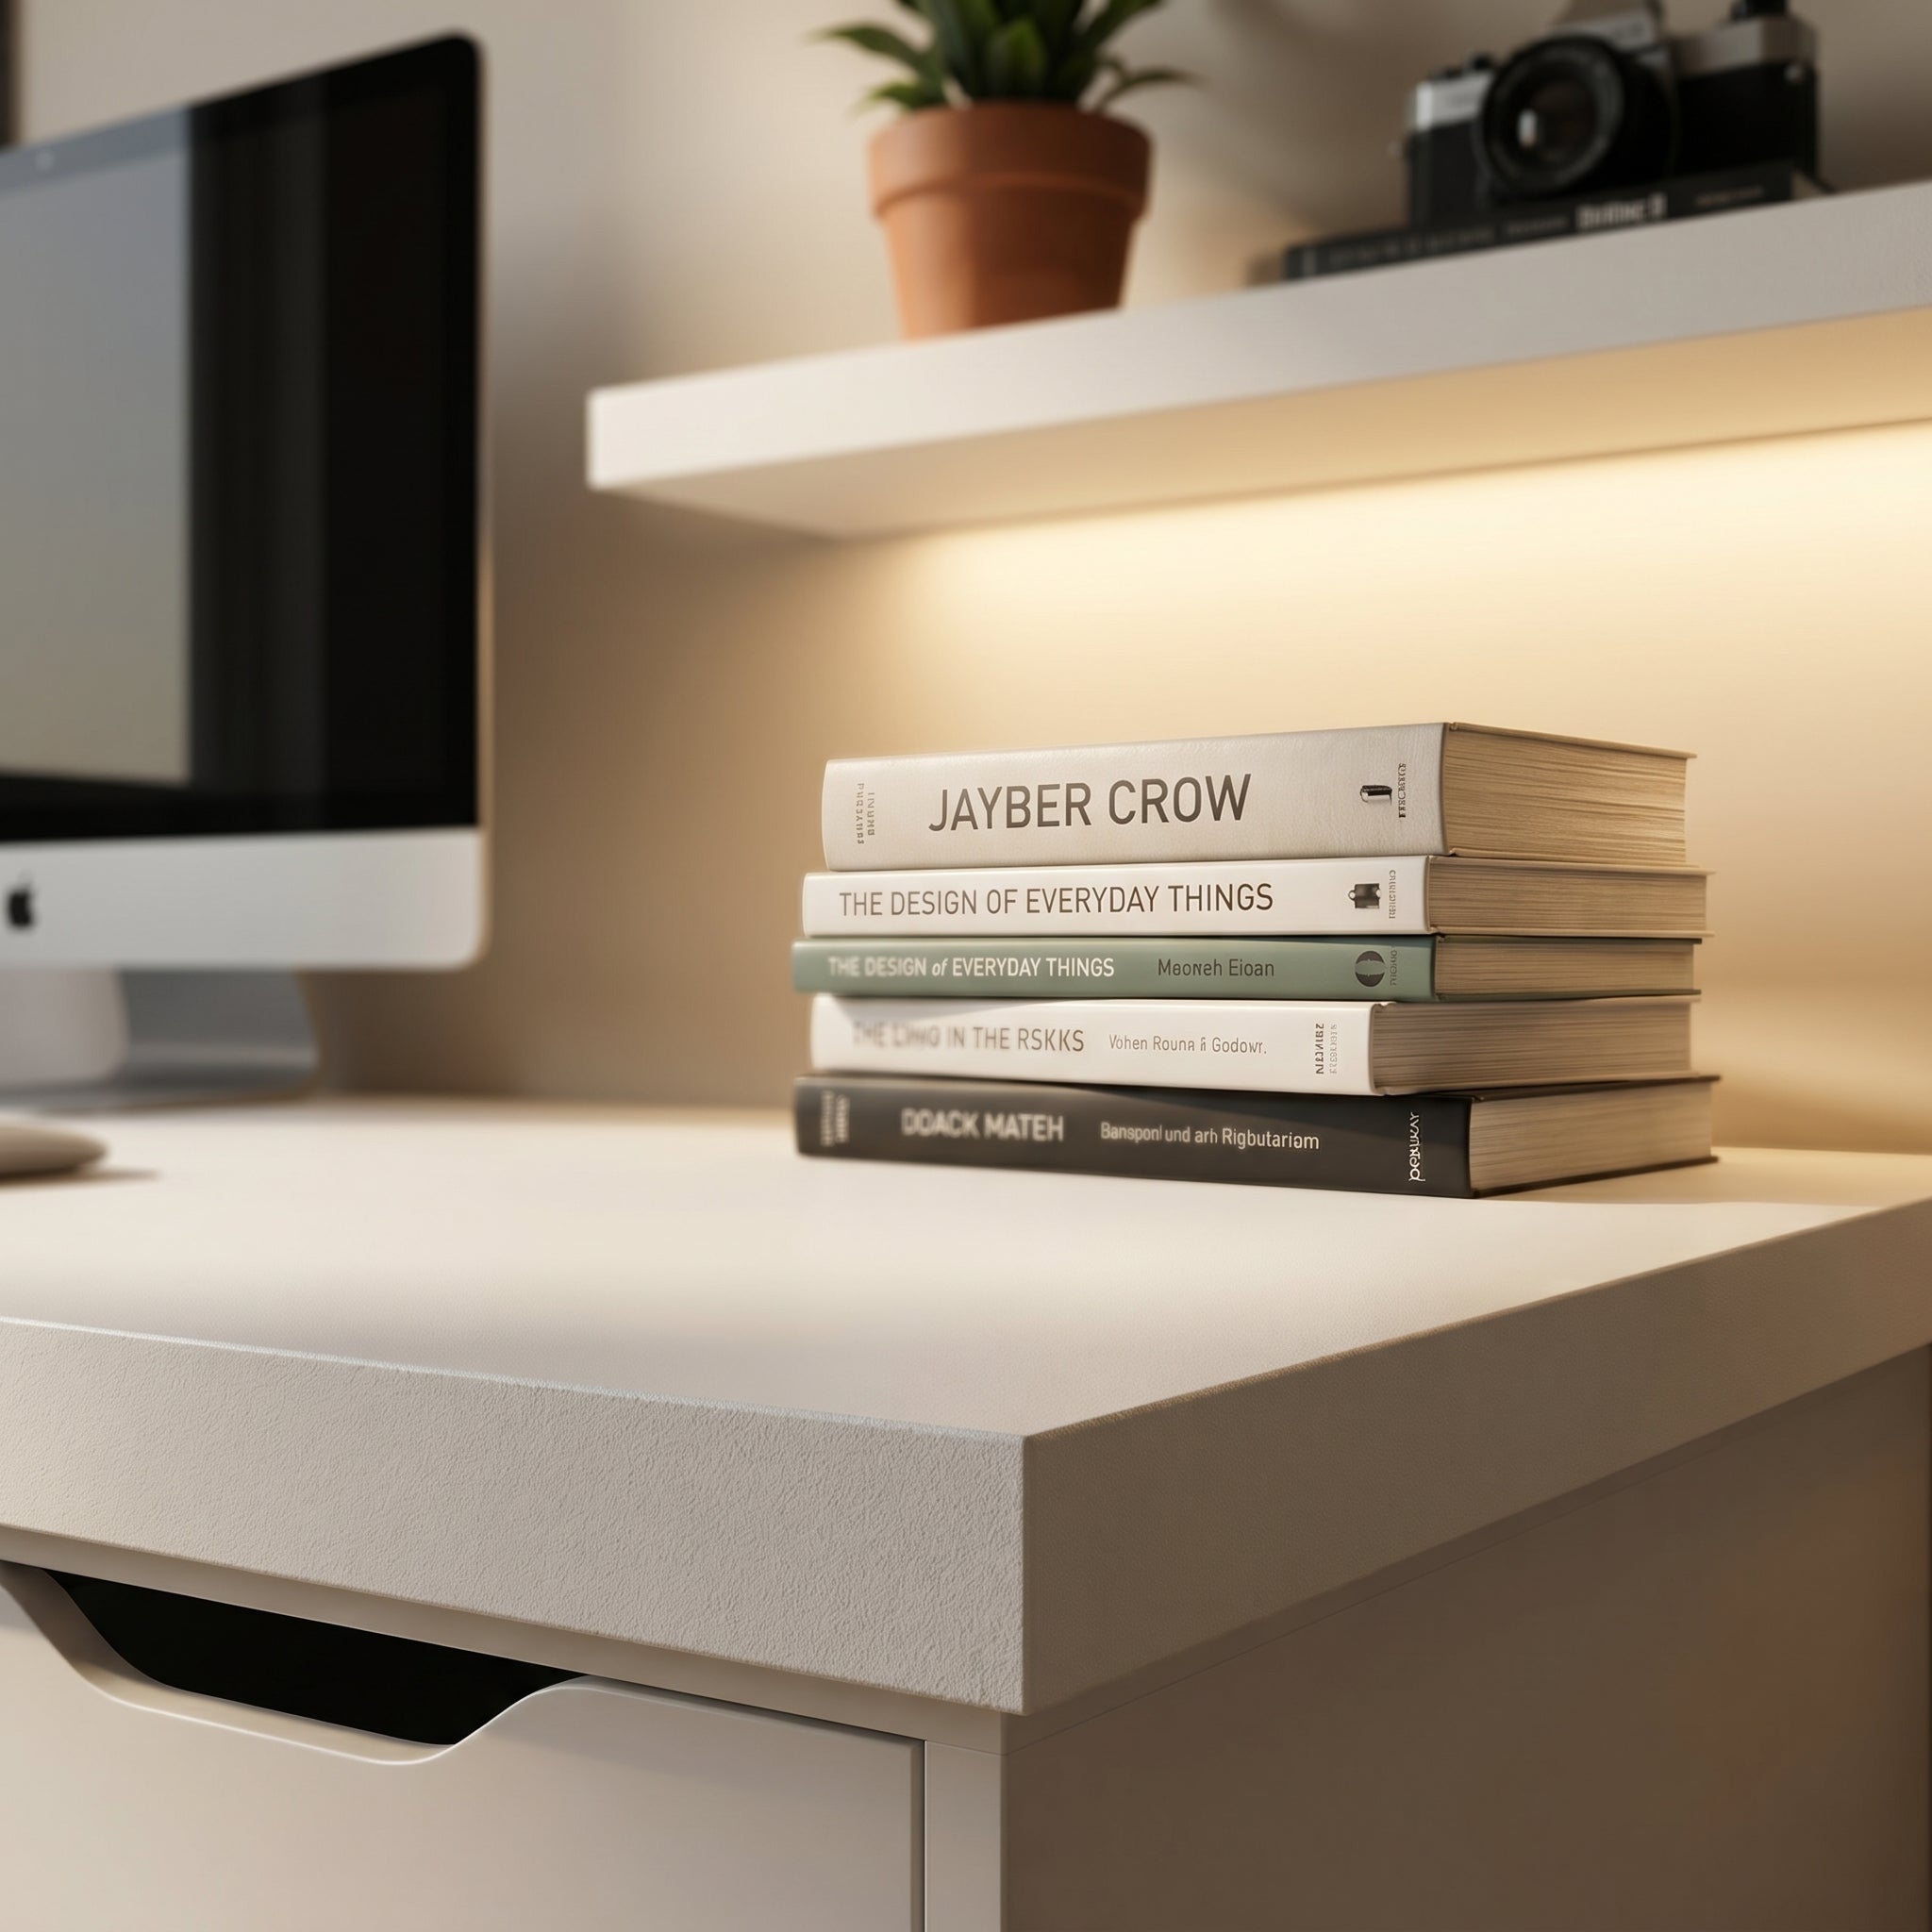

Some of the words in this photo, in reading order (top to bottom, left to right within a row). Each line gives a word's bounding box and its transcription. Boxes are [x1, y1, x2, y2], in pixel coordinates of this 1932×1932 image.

[928, 782, 1092, 832] JAYBER
[1108, 774, 1252, 825] CROW
[839, 891, 883, 917] THE
[891, 890, 977, 916] DESIGN
[987, 889, 1018, 915] OF
[1026, 886, 1159, 914] EVERYDAY
[1168, 883, 1274, 912] THINGS
[828, 956, 860, 977] THE
[865, 957, 927, 977] DESIGN
[931, 958, 949, 976] of
[953, 958, 1041, 977] EVERYDAY
[1046, 958, 1115, 977] THINGS
[948, 1027, 965, 1048] IN
[973, 1026, 1010, 1050] THE
[1018, 1028, 1085, 1053] RSKKS
[984, 1112, 1064, 1141] MATEH
